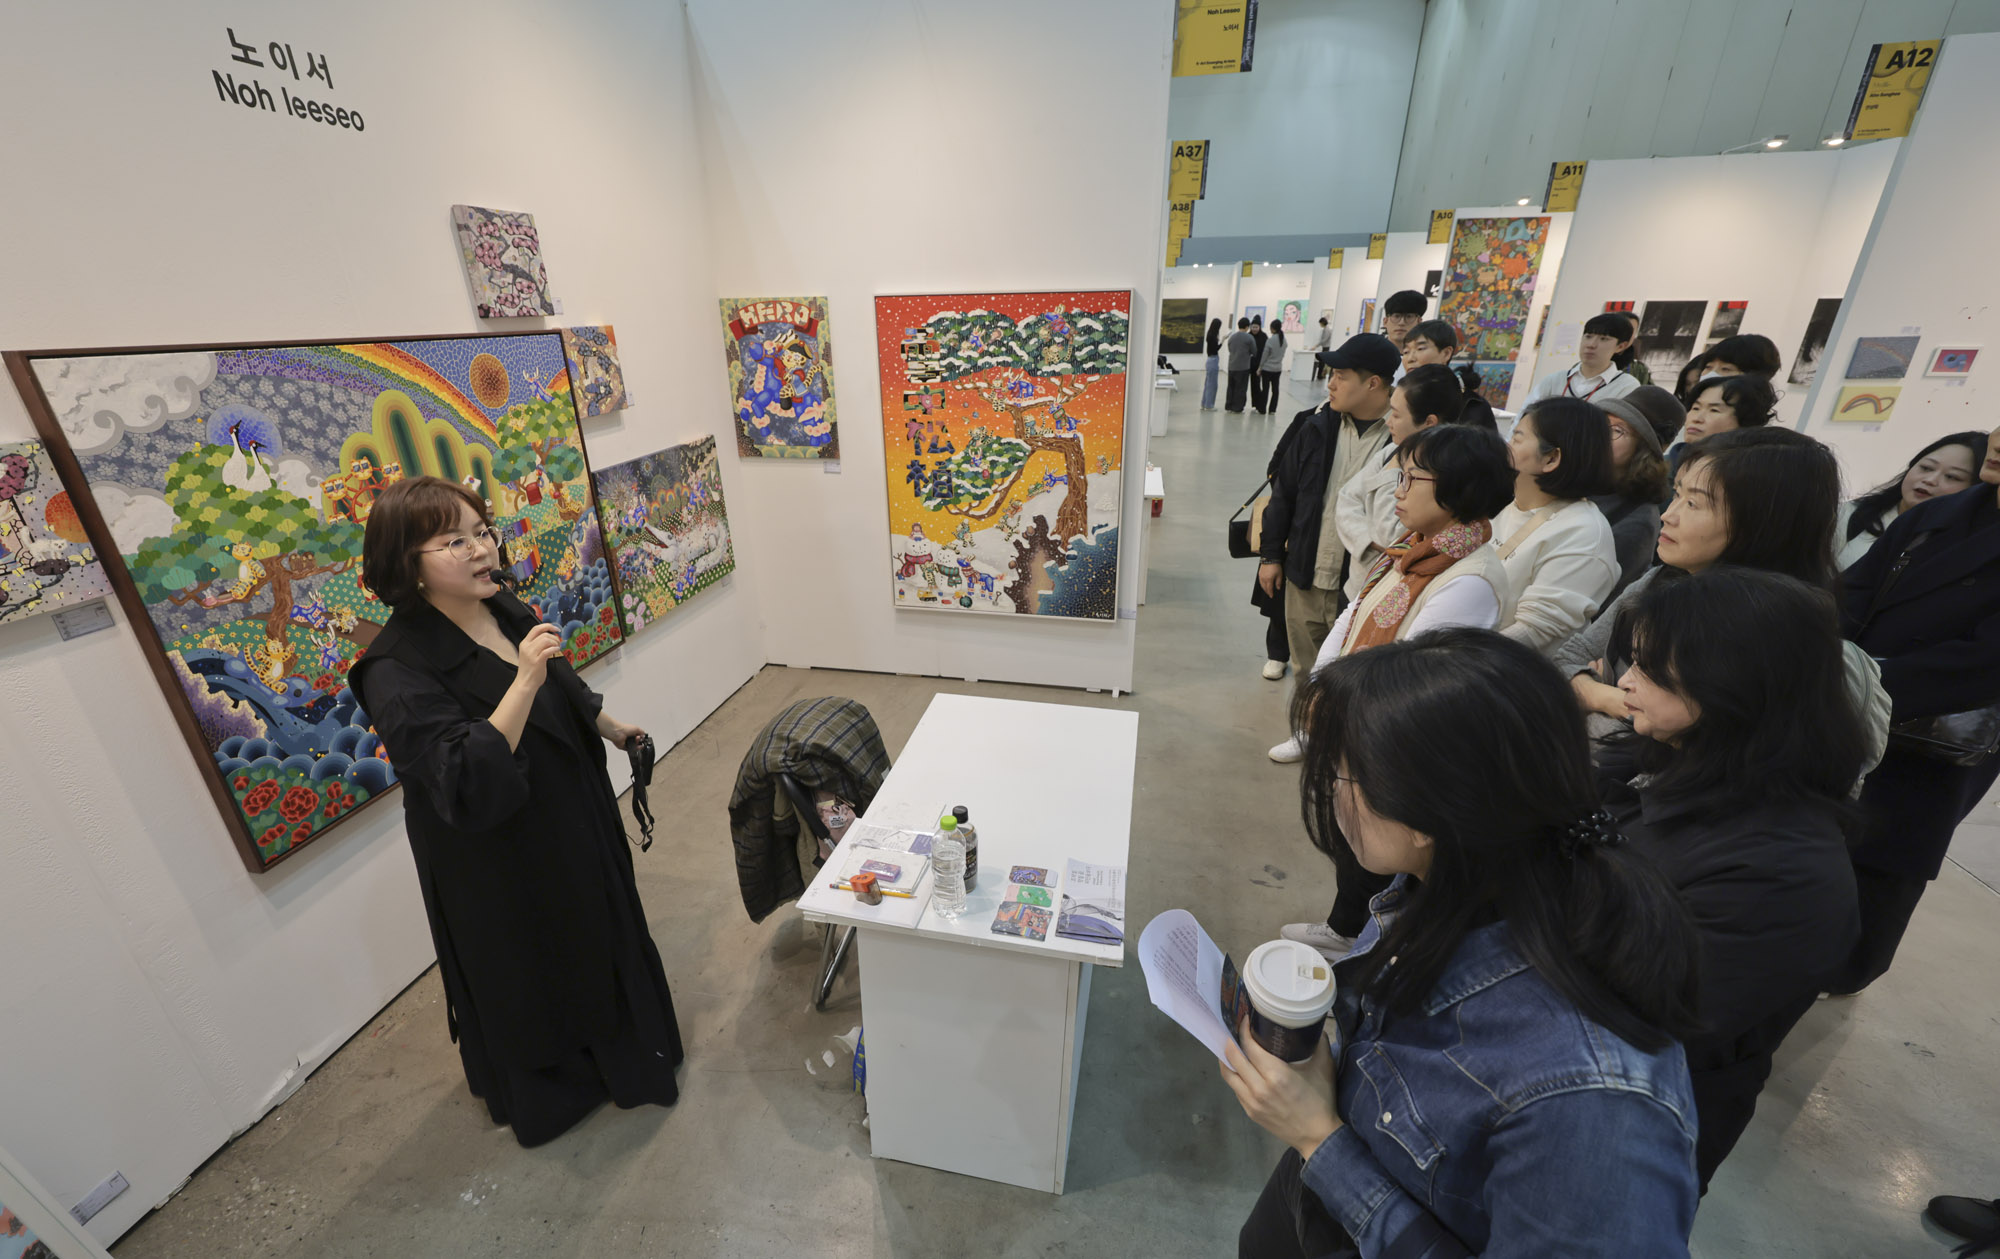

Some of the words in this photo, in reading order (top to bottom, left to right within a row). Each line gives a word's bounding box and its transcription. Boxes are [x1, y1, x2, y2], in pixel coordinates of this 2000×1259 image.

[226, 27, 334, 89] 노이서
[1885, 48, 1933, 69] A12
[212, 69, 276, 112] Noh
[1175, 145, 1202, 158] A37
[1562, 165, 1583, 176] A11
[1171, 203, 1190, 211] A38
[739, 301, 809, 328] HERO
